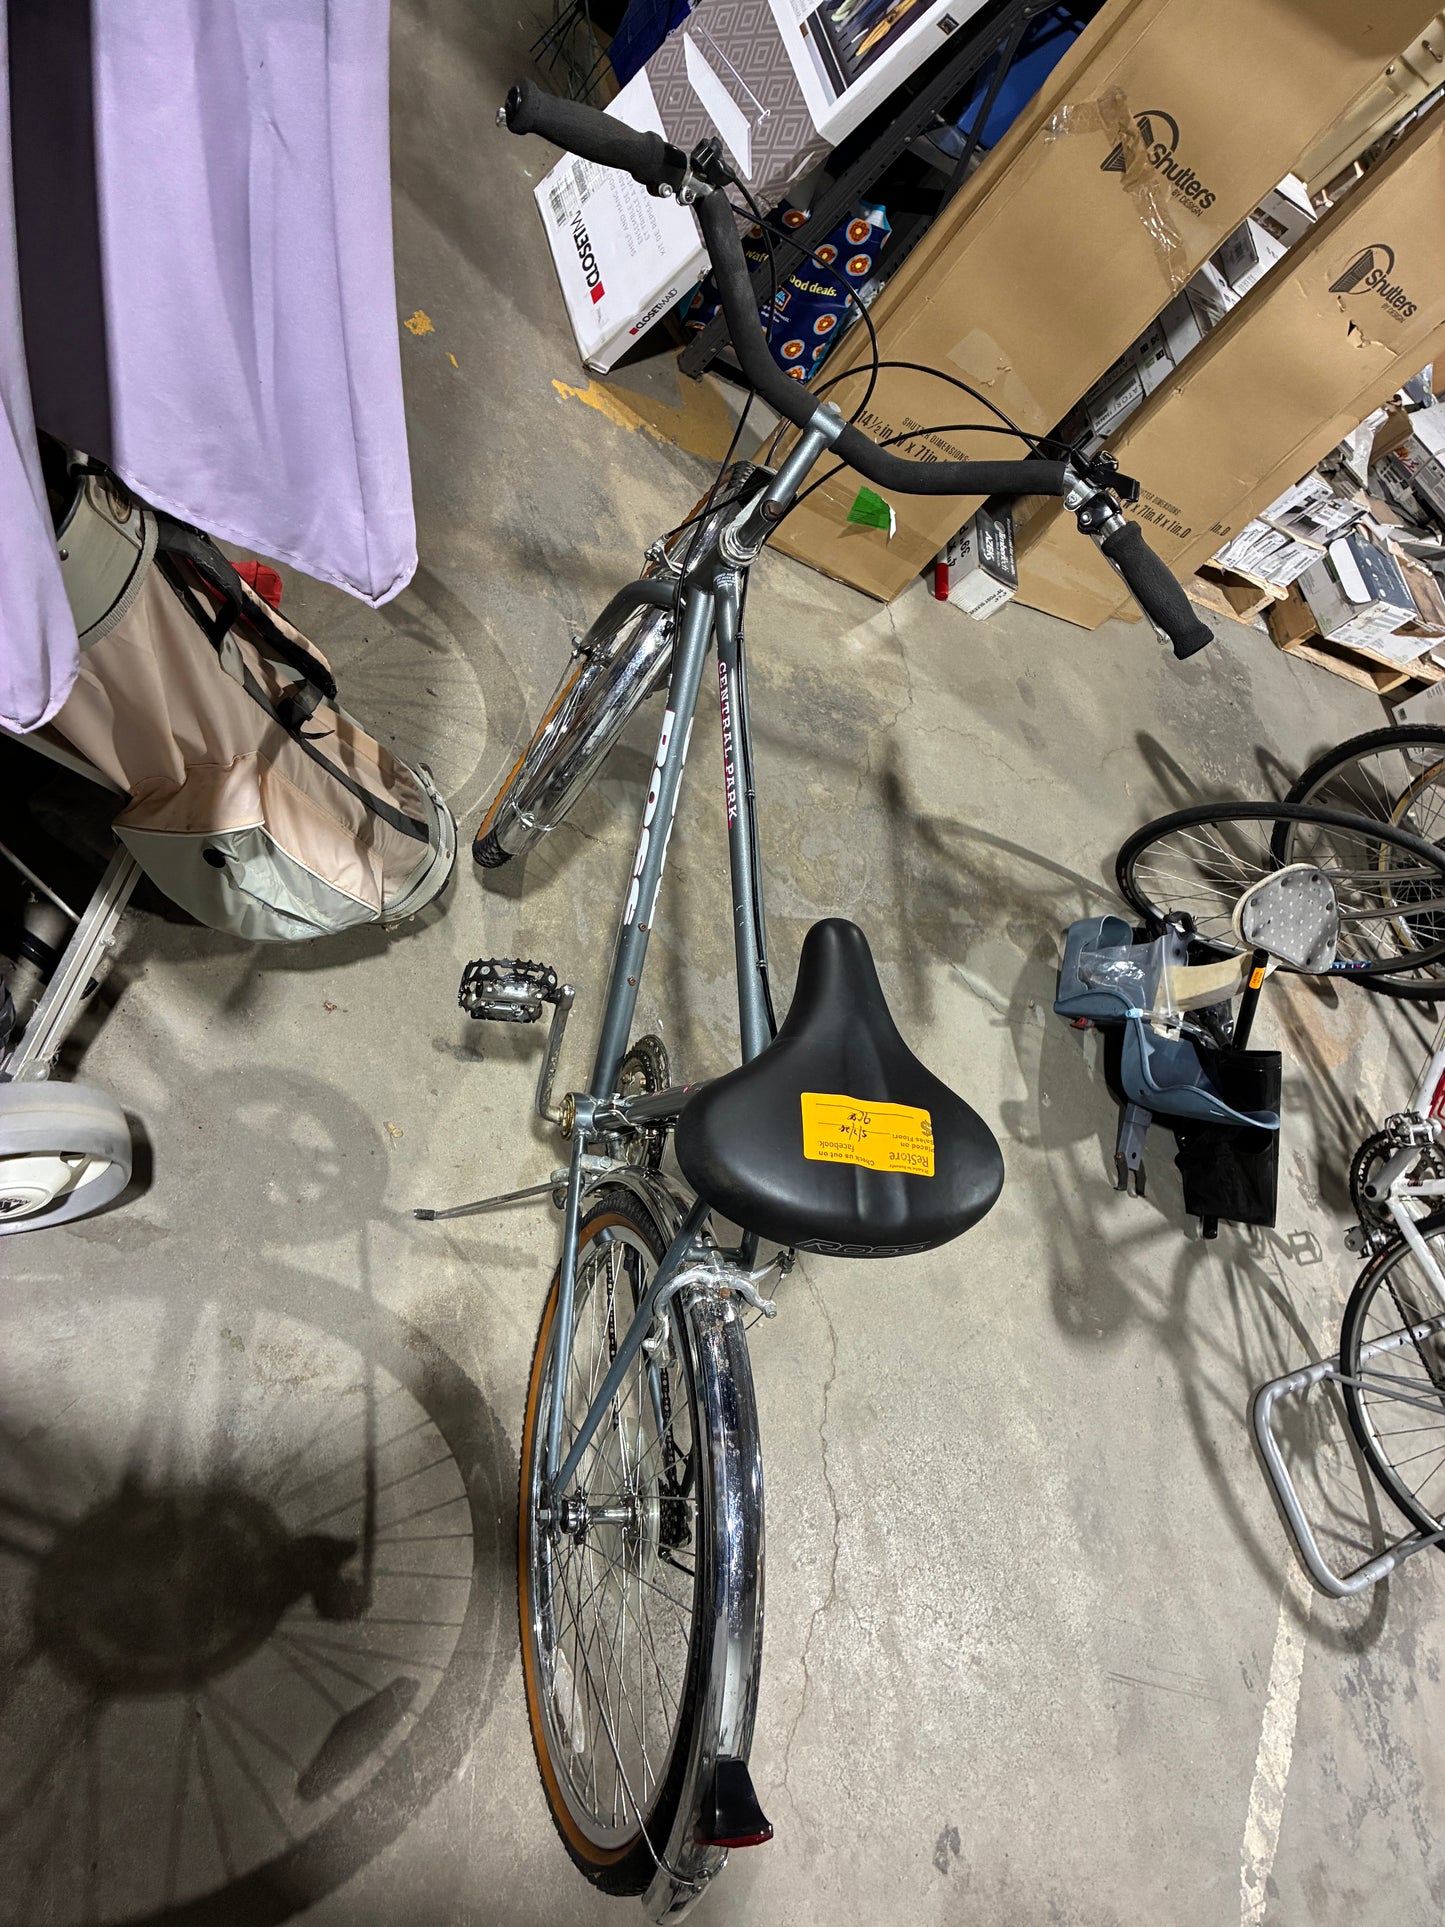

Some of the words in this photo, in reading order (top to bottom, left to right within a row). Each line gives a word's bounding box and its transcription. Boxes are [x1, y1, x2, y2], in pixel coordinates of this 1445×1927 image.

[1147, 143, 1217, 209] Shutters
[570, 210, 601, 288] CLOSETM
[635, 287, 678, 330] CLOSETMAID
[1365, 269, 1418, 317] Shutters
[1179, 527, 1192, 539] D
[718, 661, 733, 760] CENTRAL
[725, 762, 738, 822] PARK
[819, 1140, 855, 1153] facebook
[889, 1151, 929, 1168] ReStore
